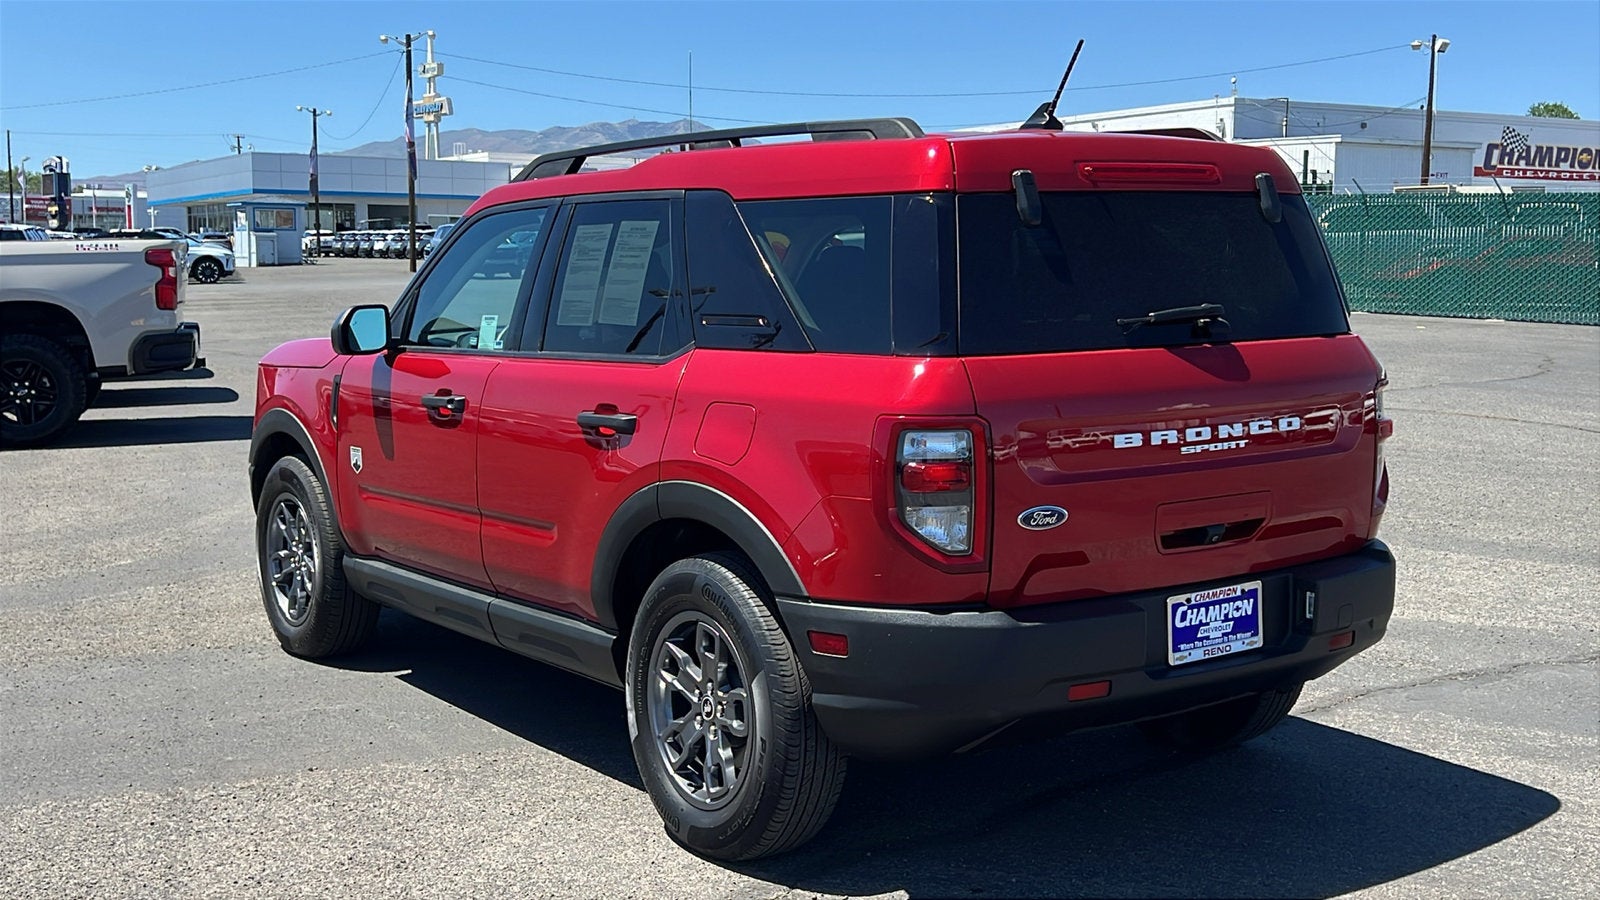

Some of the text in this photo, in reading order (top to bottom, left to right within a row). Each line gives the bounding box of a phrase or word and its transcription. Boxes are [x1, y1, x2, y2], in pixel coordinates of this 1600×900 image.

[1502, 169, 1600, 180] CHEVROLET
[1113, 416, 1301, 449] BRONCO
[1180, 439, 1249, 455] SPORT
[1030, 510, 1058, 526] Ford
[1194, 586, 1238, 603] CHAMPION
[1174, 598, 1254, 628] CHAMPION
[1199, 623, 1231, 635] CHEVROLET
[1203, 644, 1232, 657] RENO
